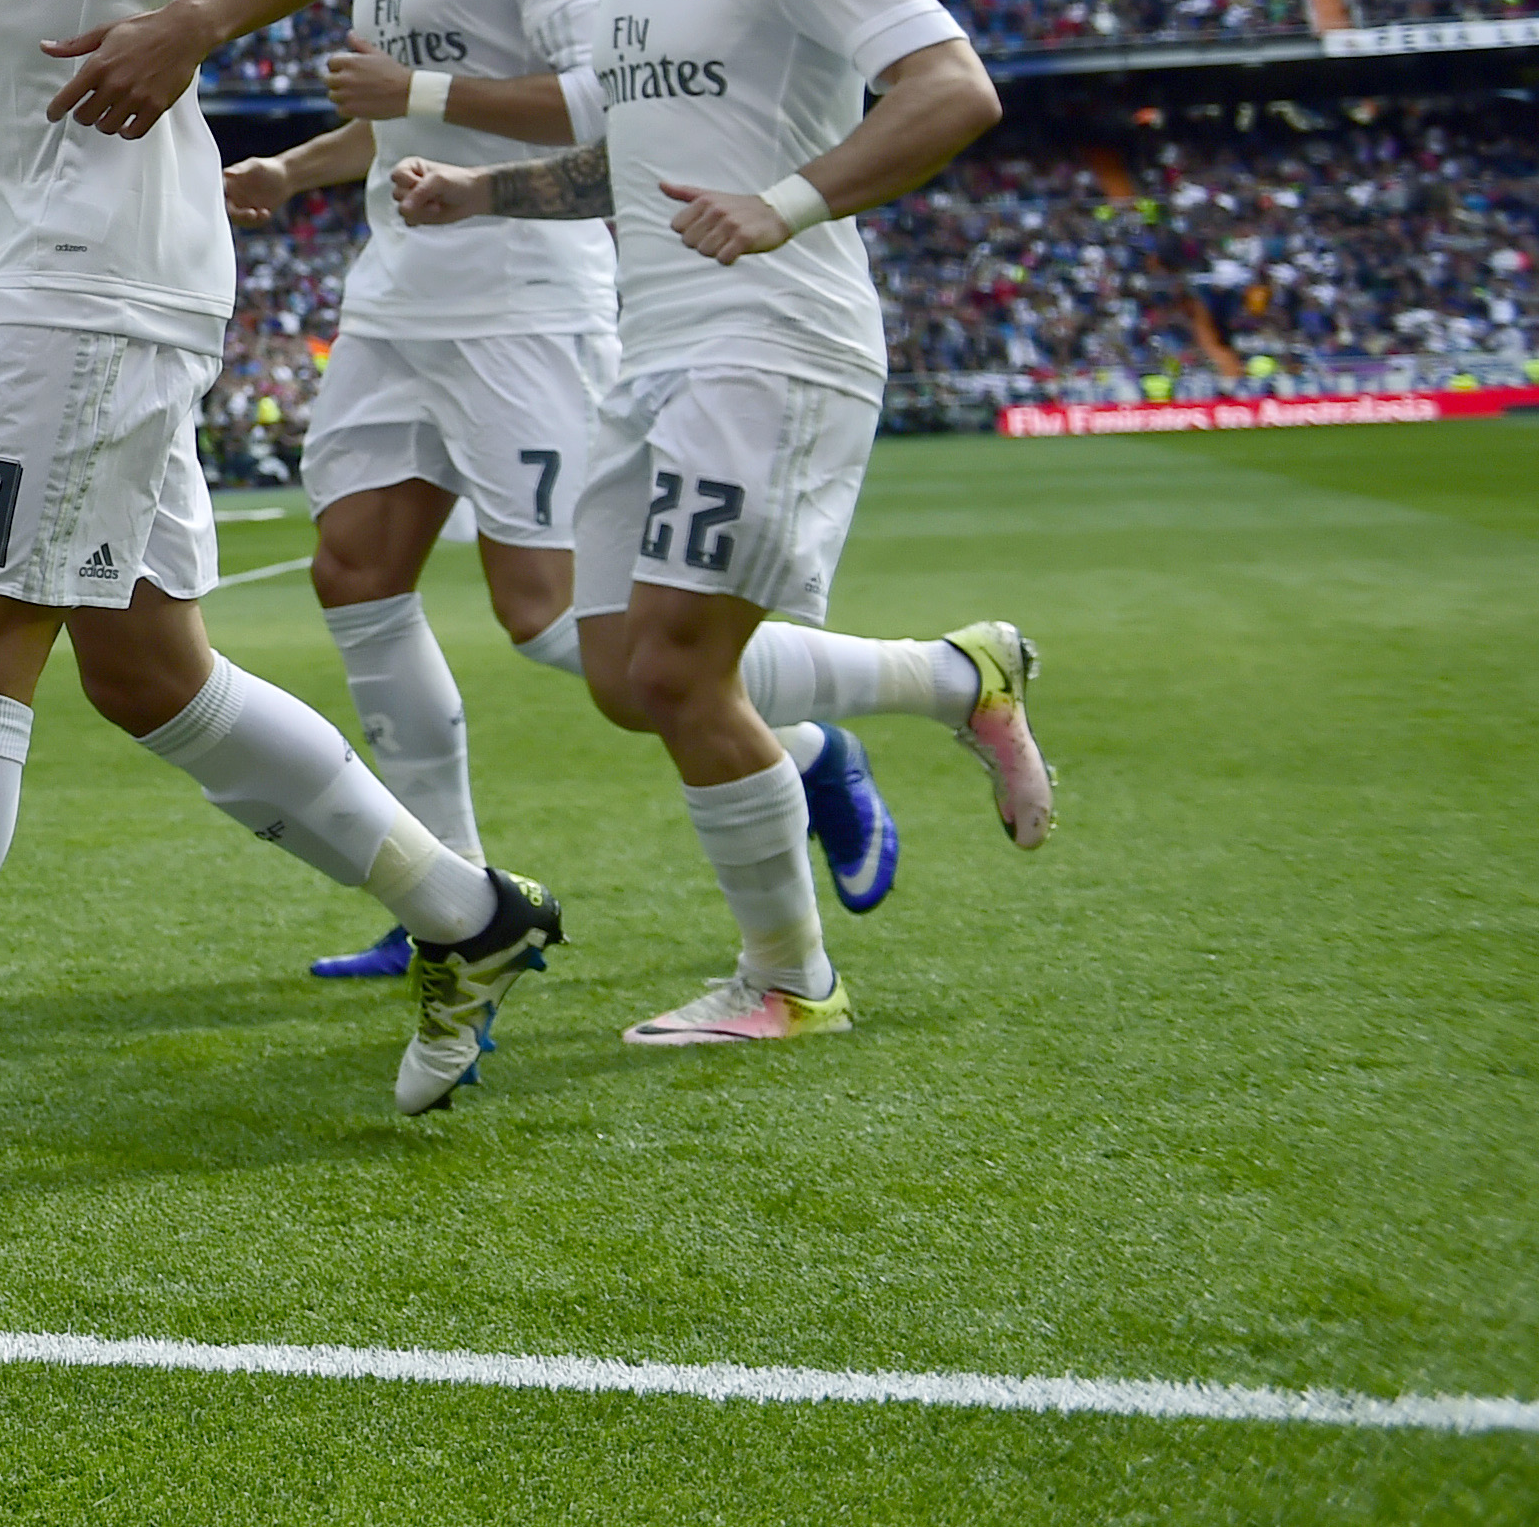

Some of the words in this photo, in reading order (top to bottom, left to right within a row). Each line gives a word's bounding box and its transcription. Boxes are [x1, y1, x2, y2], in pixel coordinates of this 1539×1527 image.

[377, 27, 468, 66] irates
[613, 14, 650, 52] Fly
[597, 53, 728, 112] mirates
[1006, 406, 1064, 436] Fly
[1067, 403, 1211, 435] Emirates
[519, 448, 562, 527] 7
[640, 470, 746, 572] 22
[79, 565, 120, 580] adidas
